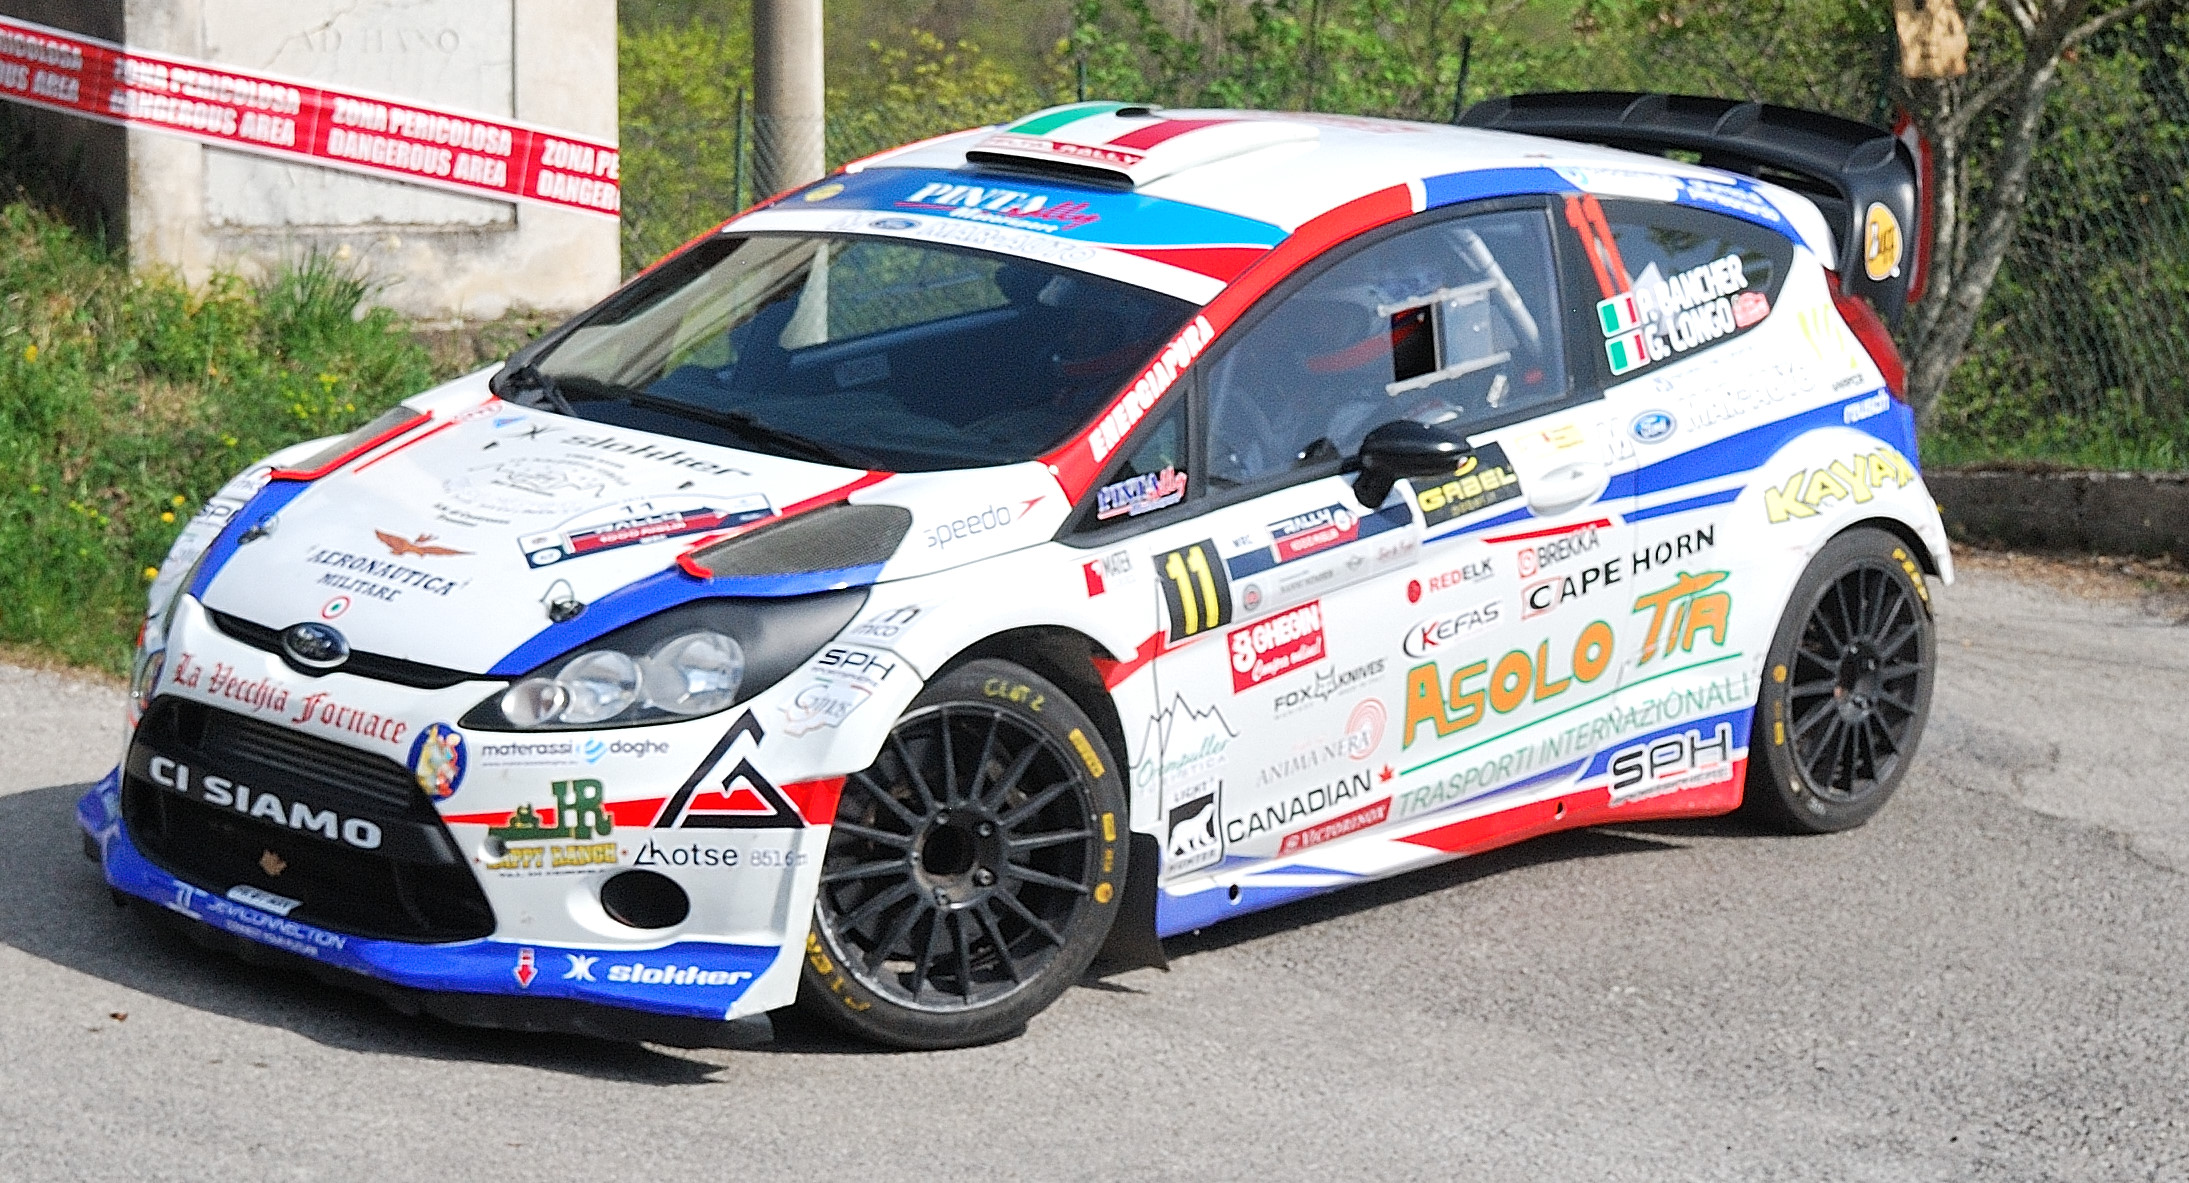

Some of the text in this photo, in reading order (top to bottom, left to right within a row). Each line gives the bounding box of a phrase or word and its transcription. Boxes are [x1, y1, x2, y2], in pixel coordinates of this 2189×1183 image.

[32, 69, 80, 103] AREA
[113, 57, 301, 115] ZONA PERICOLOSA
[109, 87, 296, 147] DANGEROUS AREA
[331, 97, 513, 157] ZONA PERICOLOSA
[327, 128, 507, 188] DANGEROUS AREA
[541, 138, 596, 174] ZONA
[1645, 324, 1672, 362] G.
[1666, 297, 1736, 352] LONGO
[1088, 315, 1215, 463] ENERGIAPURA
[1418, 467, 1517, 512] GABEL
[923, 505, 1012, 549] speedo
[317, 573, 402, 602] MILITARE
[1166, 544, 1219, 636] 11
[1428, 558, 1493, 592] REDELK
[1529, 524, 1715, 611] CAPE HORN
[1252, 604, 1320, 654] GHEGIN
[1421, 601, 1502, 651] KEFAS
[818, 649, 896, 681] SPH
[1401, 620, 1614, 750] ASOLO
[173, 653, 408, 744] La Vecchia Fornace
[1274, 686, 1313, 712] FOX
[481, 738, 670, 759] materassi doghe
[1400, 745, 1534, 816] TRASPORTI
[1534, 671, 1752, 764] INTERNAZIONALI
[1612, 728, 1728, 790] SPH
[150, 756, 383, 850] CI SIAMO
[1227, 768, 1373, 845] CANADIAN
[551, 843, 618, 867] RANCH
[607, 962, 753, 986] slokker
